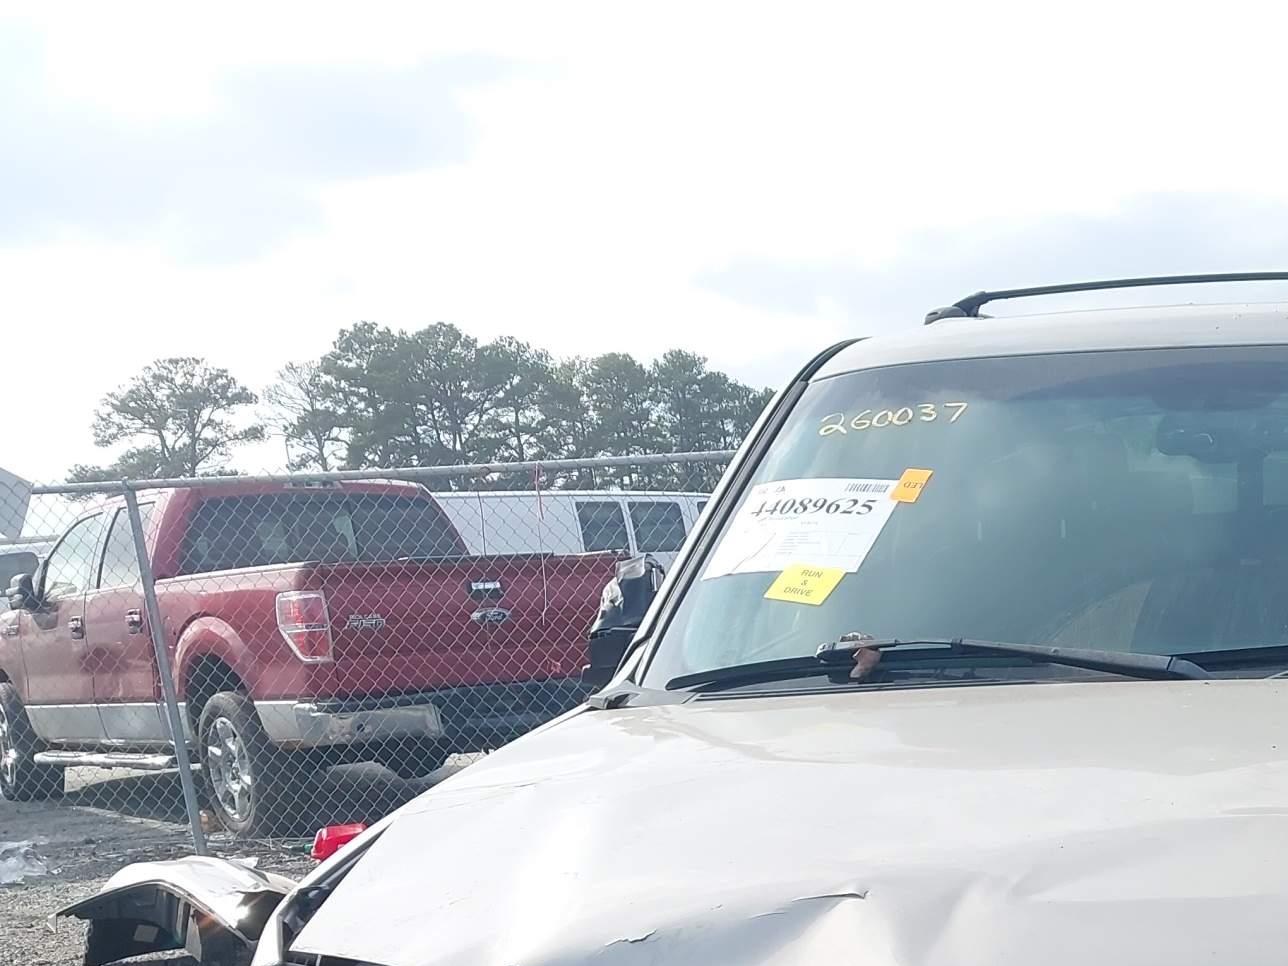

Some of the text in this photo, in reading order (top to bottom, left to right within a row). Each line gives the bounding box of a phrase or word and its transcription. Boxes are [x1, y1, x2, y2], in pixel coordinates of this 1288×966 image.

[818, 402, 968, 436] 260037
[752, 497, 877, 517] 44089625
[800, 569, 823, 579] RUN
[783, 587, 814, 597] DRIVE
